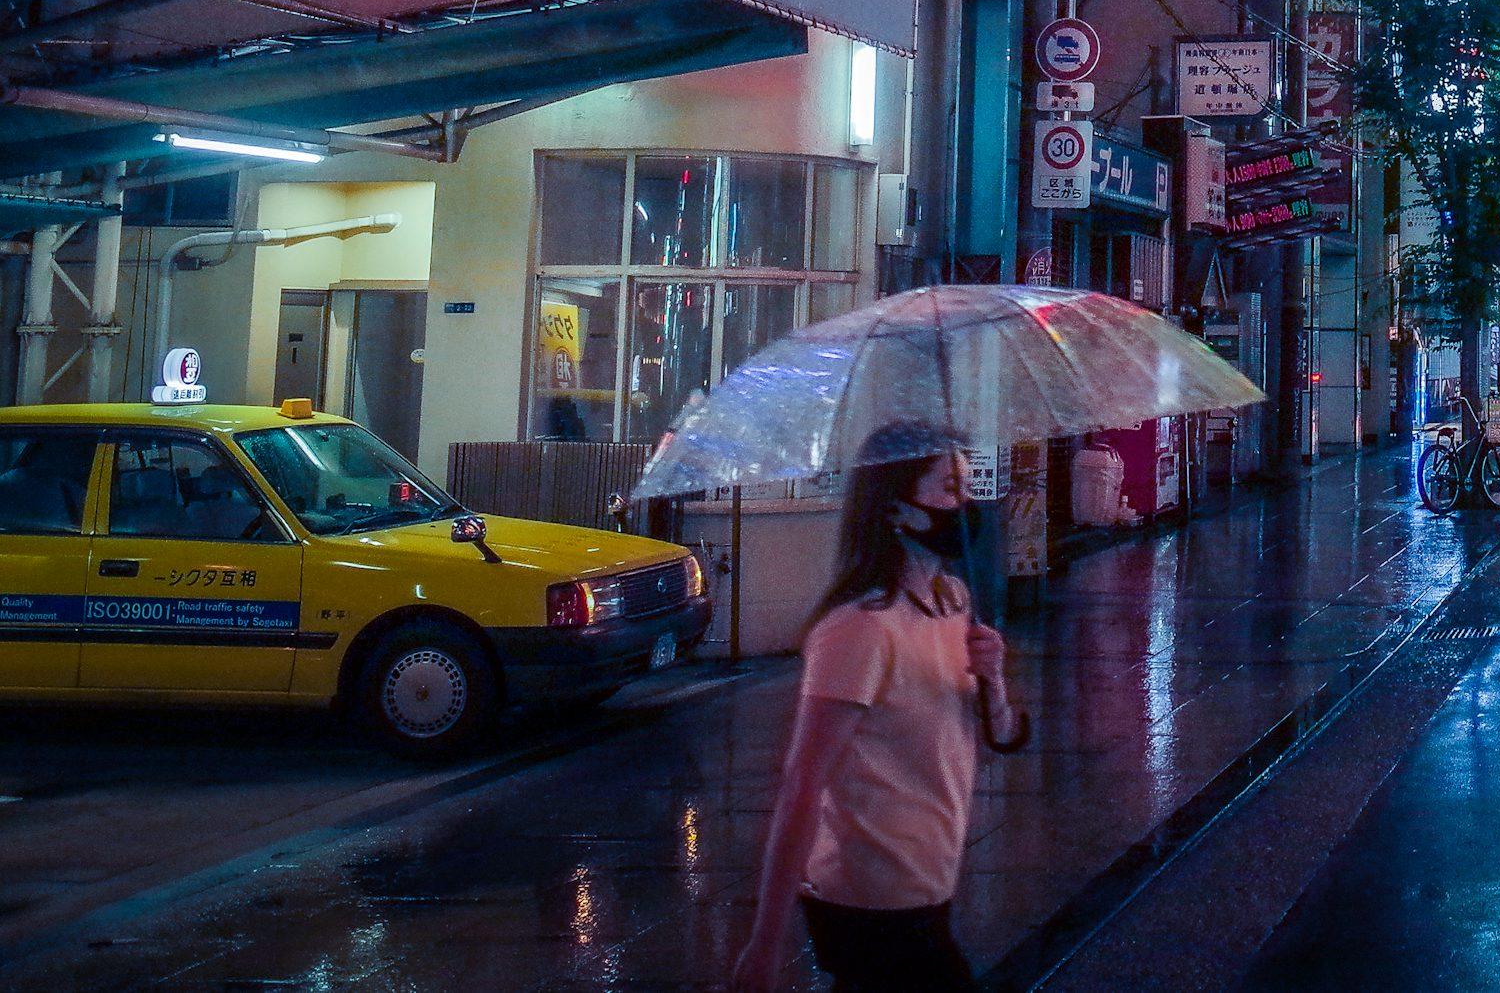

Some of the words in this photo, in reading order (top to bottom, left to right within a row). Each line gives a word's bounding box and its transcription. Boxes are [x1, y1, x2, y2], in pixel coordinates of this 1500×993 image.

[1052, 138, 1075, 157] 30
[1040, 188, 1082, 199] ここから
[1, 598, 34, 608] Quality
[177, 600, 201, 611] Road
[205, 603, 233, 612] traffic
[236, 604, 265, 614] safety
[176, 615, 235, 626] Management
[237, 617, 249, 627] by
[252, 618, 293, 628] Sogotaxi
